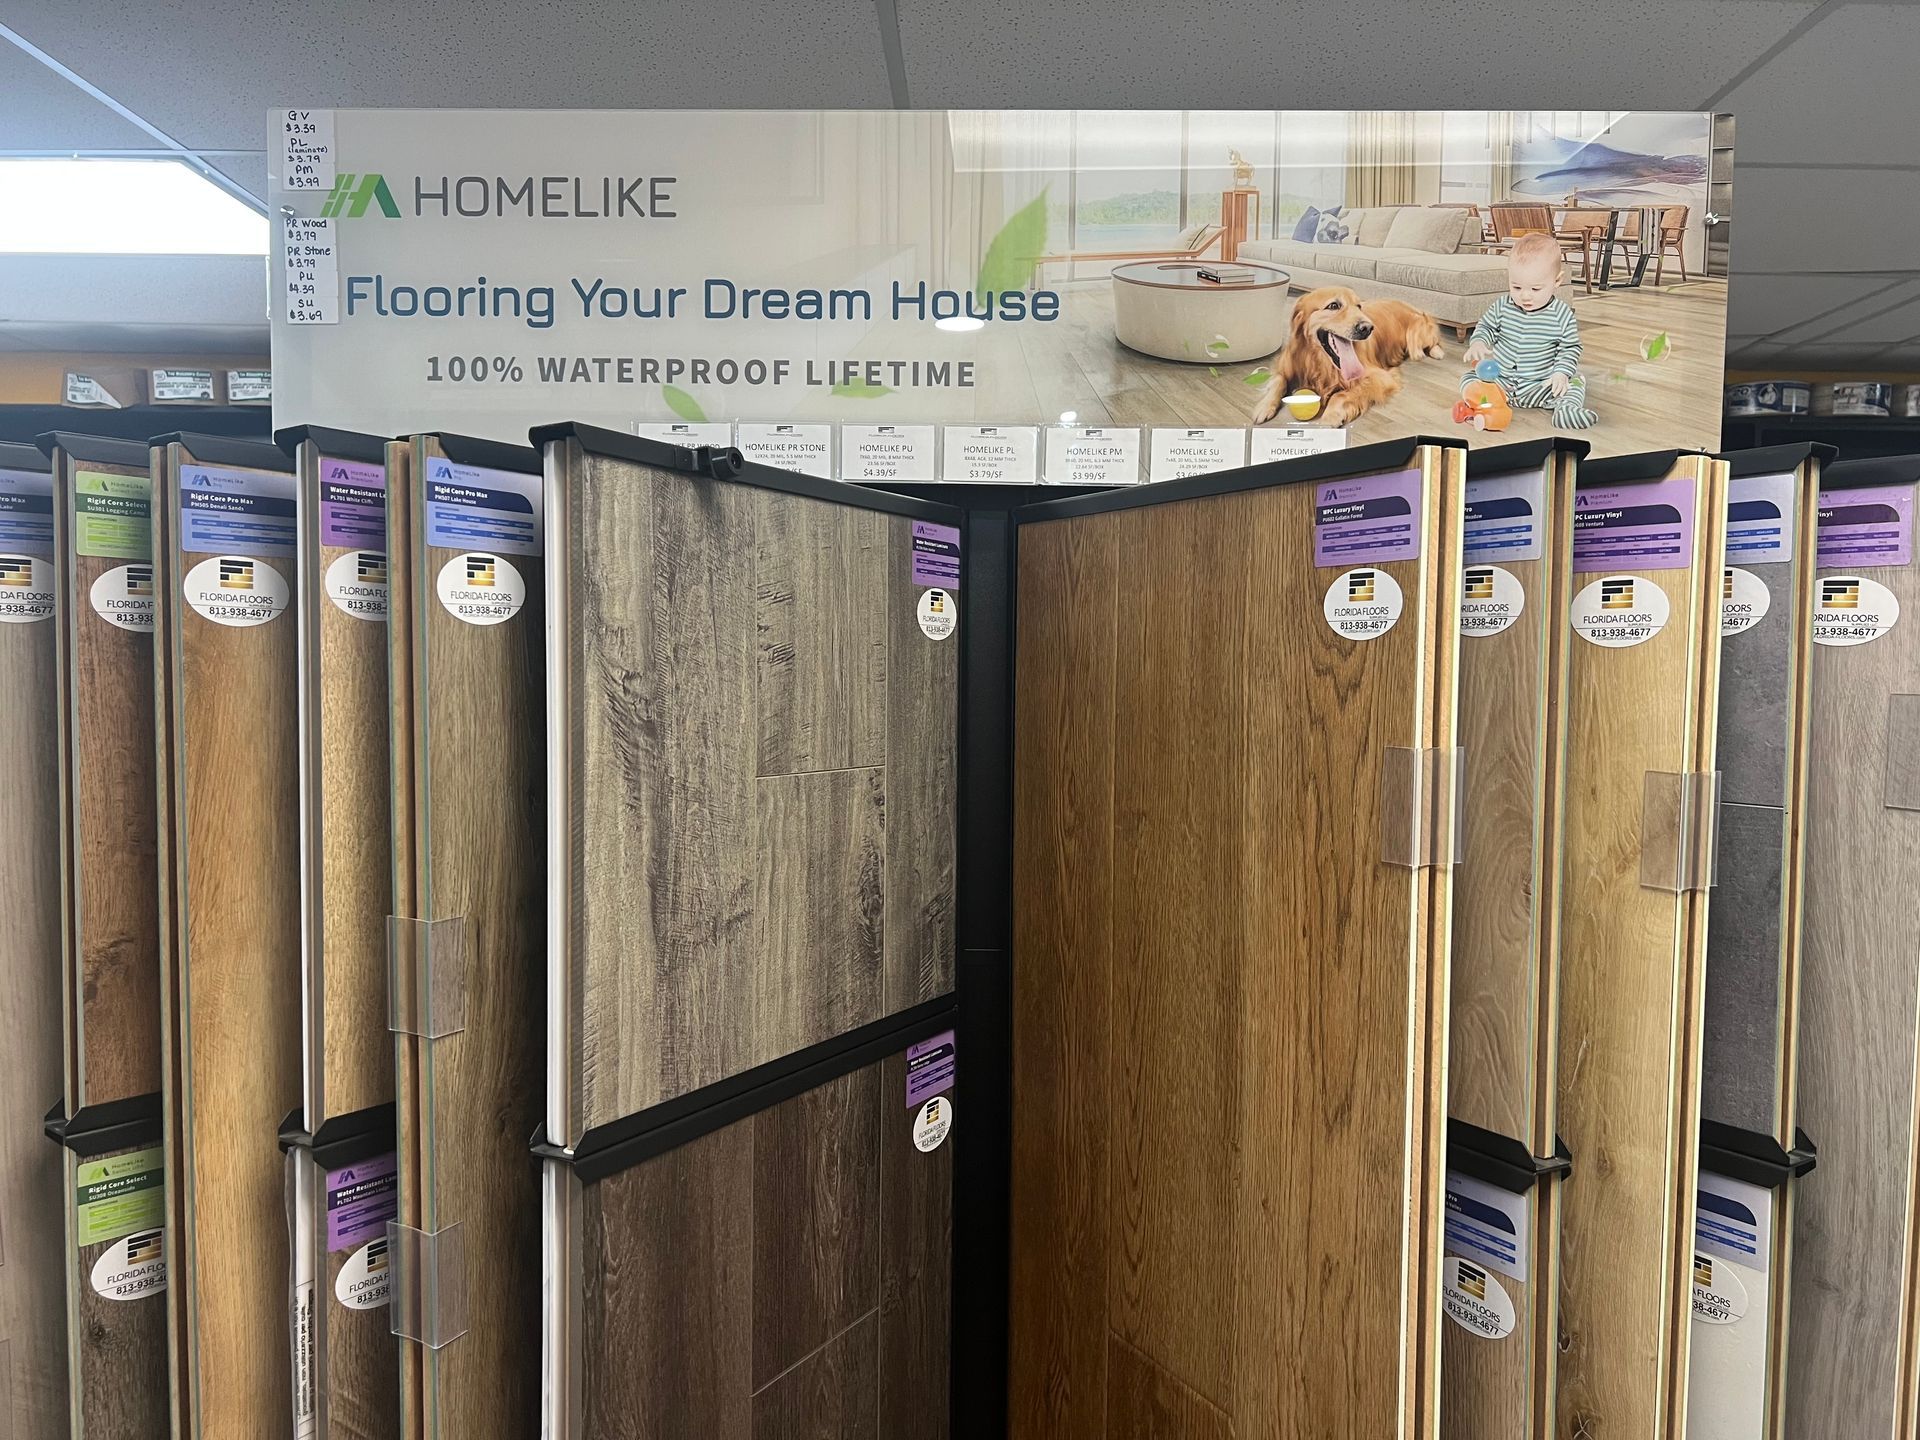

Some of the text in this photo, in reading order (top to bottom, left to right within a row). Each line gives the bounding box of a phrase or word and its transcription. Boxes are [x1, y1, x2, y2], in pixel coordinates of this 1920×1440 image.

[286, 123, 315, 133] $3.39
[290, 138, 308, 148] PL
[288, 155, 321, 163] $3.79
[289, 176, 319, 187] $3.99
[415, 176, 677, 218] HOMELIKE
[286, 219, 327, 228] PR Wood
[288, 230, 317, 241] $3.79
[288, 246, 331, 256] PR Stone
[288, 258, 316, 268] $3.79
[289, 283, 315, 294] $4.39
[347, 275, 1060, 328] Flooring Your Dream House
[290, 310, 322, 321] $3.69
[426, 356, 975, 387] 100% WATERPROOF LIFETIME
[746, 443, 785, 451] HOMELIKE
[859, 444, 900, 452] HOMELIKE
[963, 445, 1015, 454] HOMELIKE PL
[1109, 448, 1123, 456] PM
[1169, 448, 1207, 456] HOMELIKE
[1271, 448, 1308, 456] HOMELIKE
[863, 468, 897, 477] $4.39/SF
[969, 470, 1003, 478] $3.79/SF
[1072, 472, 1107, 480] $3.99/SF
[329, 486, 349, 494] Water
[349, 489, 378, 498] Resistant
[434, 486, 450, 494] Rigid
[87, 497, 106, 505] Rigid
[190, 493, 209, 501] Rigid
[107, 507, 128, 515] Logging
[1334, 506, 1350, 514] Luxury
[1351, 504, 1365, 512] Vinyl
[1584, 512, 1605, 520] Luxury
[1606, 511, 1623, 519] Vinyl
[17, 592, 54, 601] FLOORS
[339, 586, 374, 597] FLORIDA
[450, 590, 512, 602] FLORIDA FLOORS
[200, 592, 274, 605] FLORIDA FLOORS
[107, 599, 147, 609] FLORIDA
[347, 601, 387, 611] 813-938-
[1480, 603, 1509, 612] FLOORS
[1722, 603, 1752, 613] LOORS
[209, 606, 272, 617] 813-938-4677
[458, 605, 512, 615] 813-938-4677
[1334, 606, 1389, 616] FLORIDA FLOORS
[1583, 613, 1652, 624] FLORIDA FLOORS
[1722, 617, 1750, 626] -4677
[1841, 614, 1879, 623] FLOORS
[1340, 620, 1388, 630] 813-938-4677
[1590, 628, 1651, 637] 813-938-4677
[88, 1175, 147, 1194] Rigid Core Select
[336, 1188, 356, 1198] Water
[356, 1179, 384, 1193] Resistant
[107, 1267, 146, 1284] FLORIDA
[349, 1276, 384, 1294] FLORIDA
[1697, 1288, 1731, 1308] FLOORS
[1443, 1285, 1472, 1308] FLORIDA
[1471, 1298, 1501, 1323] FLOORS
[1447, 1302, 1499, 1335] 813-938-4677
